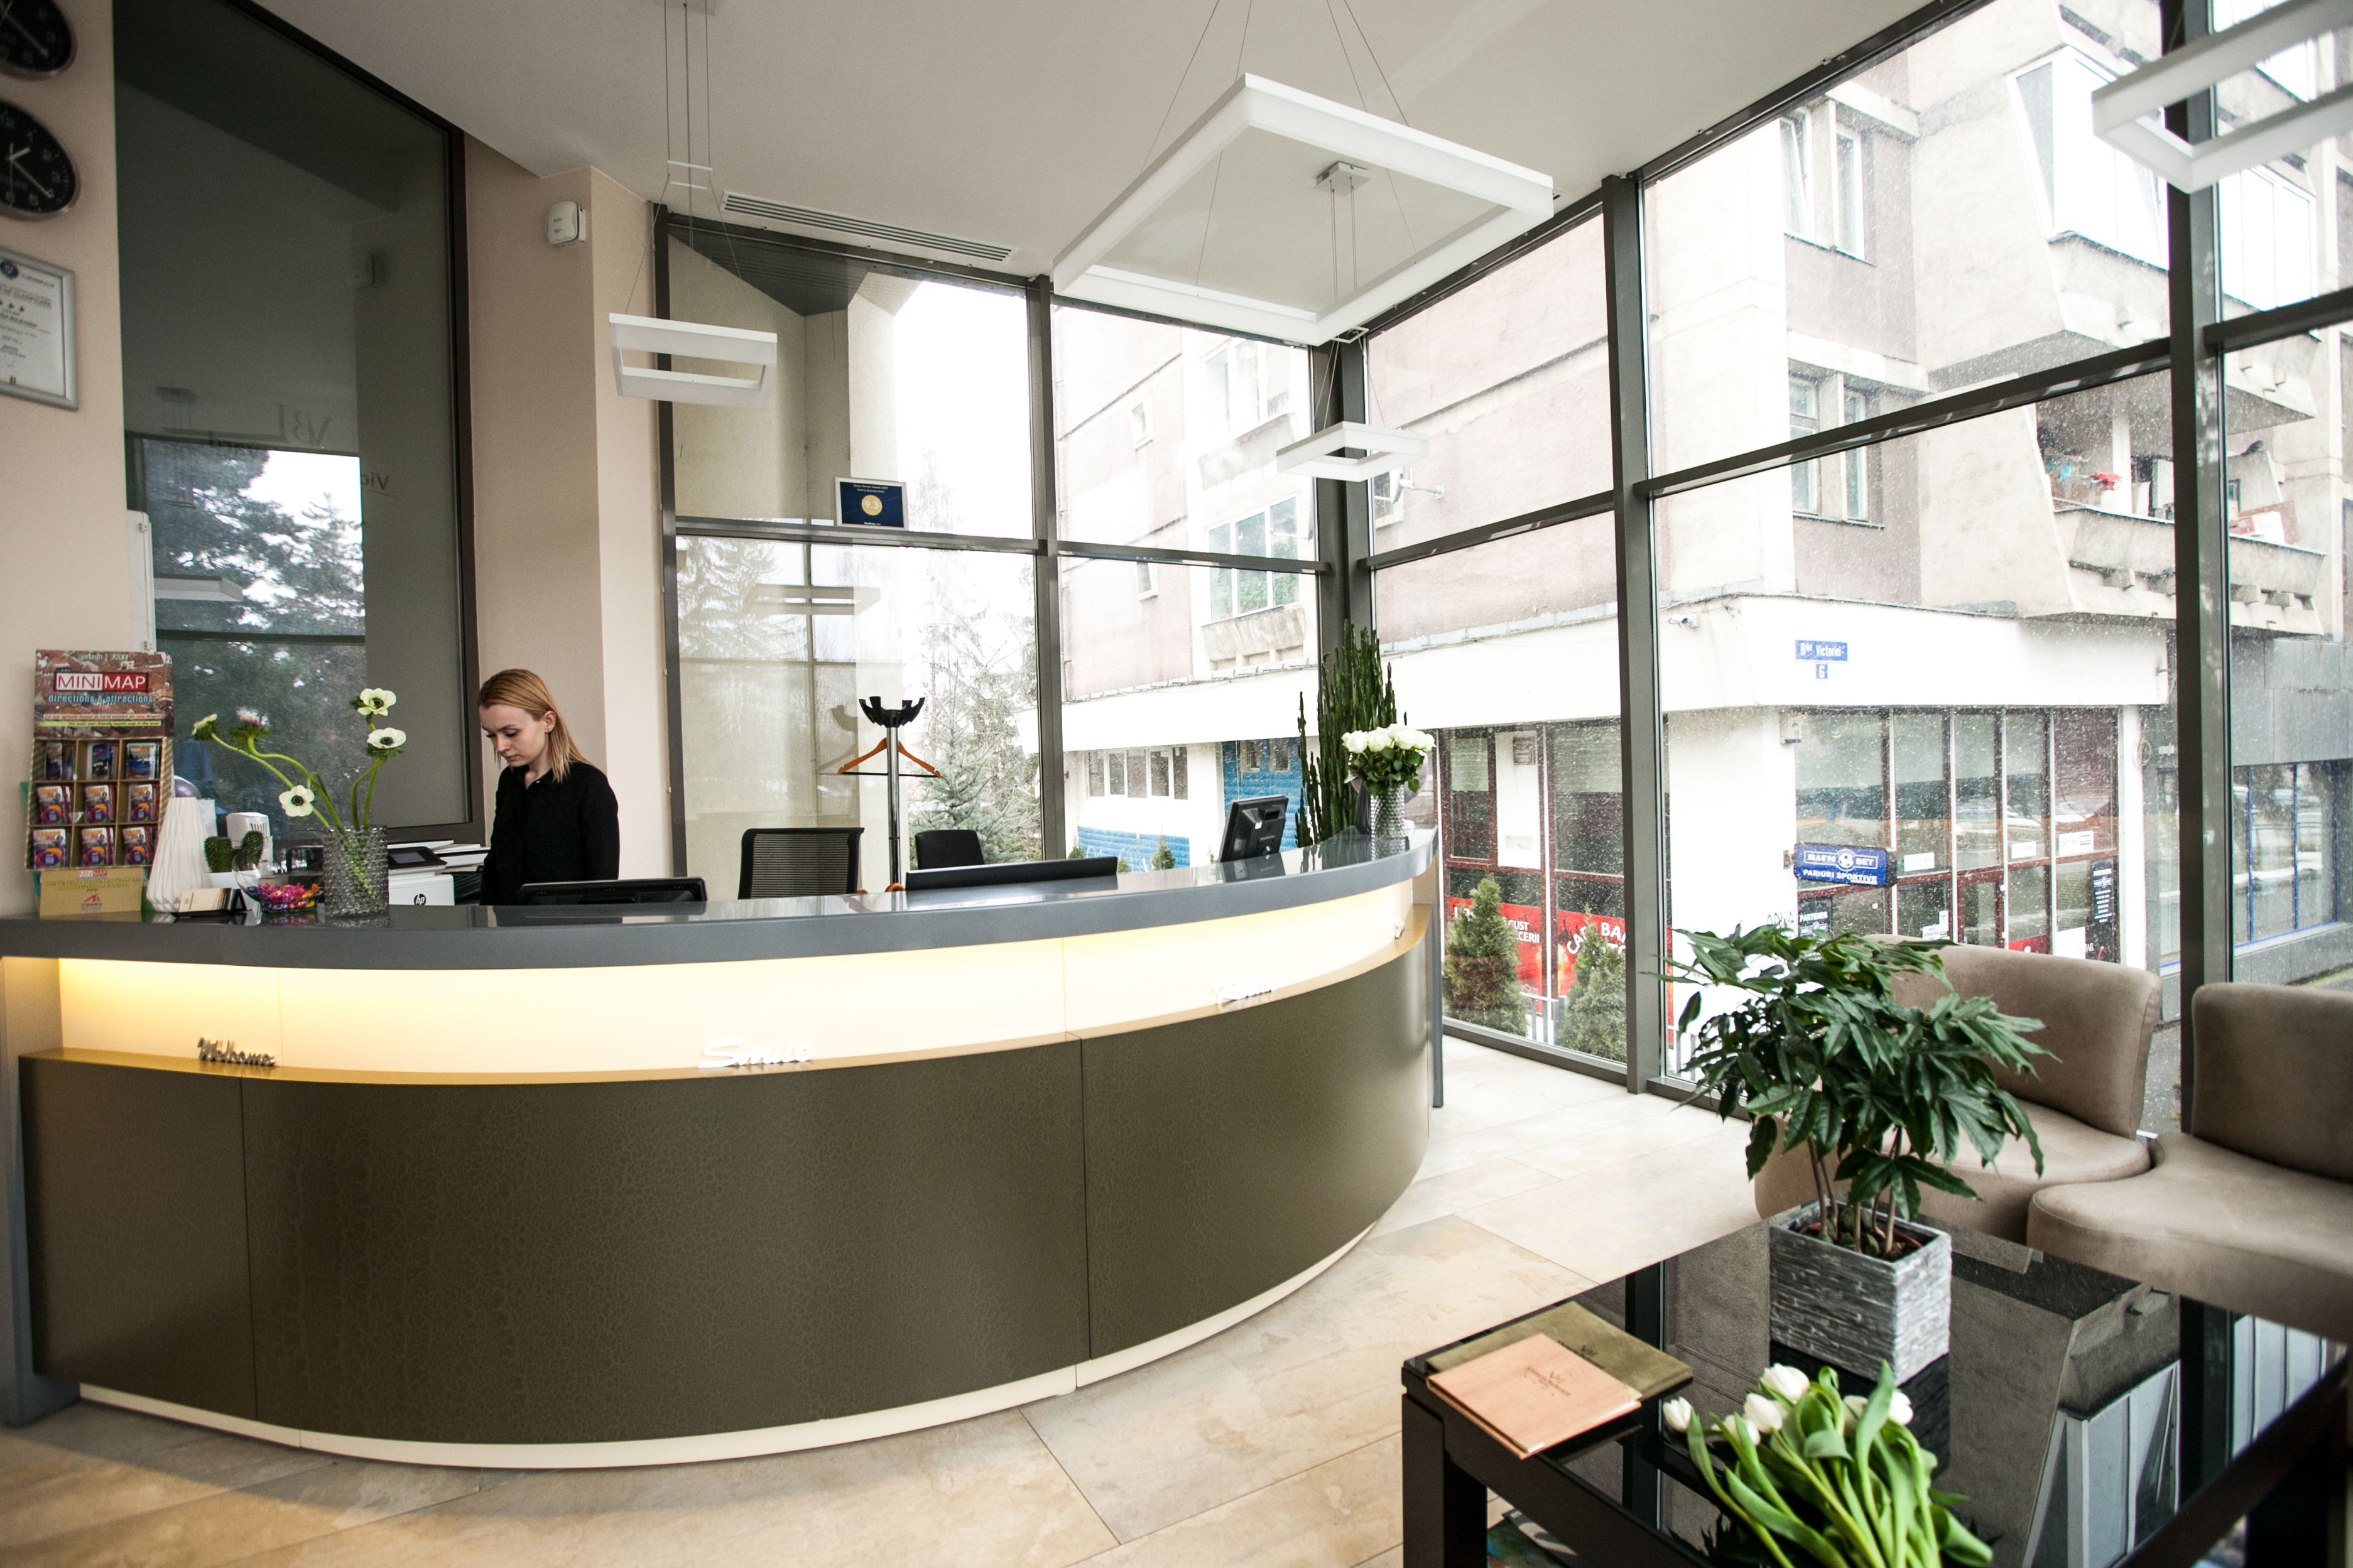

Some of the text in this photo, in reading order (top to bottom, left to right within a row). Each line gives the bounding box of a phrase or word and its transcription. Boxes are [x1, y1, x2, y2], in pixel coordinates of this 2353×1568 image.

[864, 501, 879, 510] 9.3
[1818, 665, 1825, 679] 6
[48, 695, 94, 703] directions
[106, 695, 153, 703] attractions
[1856, 858, 1874, 866] BET
[1803, 869, 1878, 882] PARIURI SPORTIVE
[415, 894, 425, 905] hp
[1517, 931, 1540, 944] CERII
[1567, 925, 1587, 954] CAF
[1601, 921, 1626, 943] BA
[698, 1037, 815, 1068] Smile
